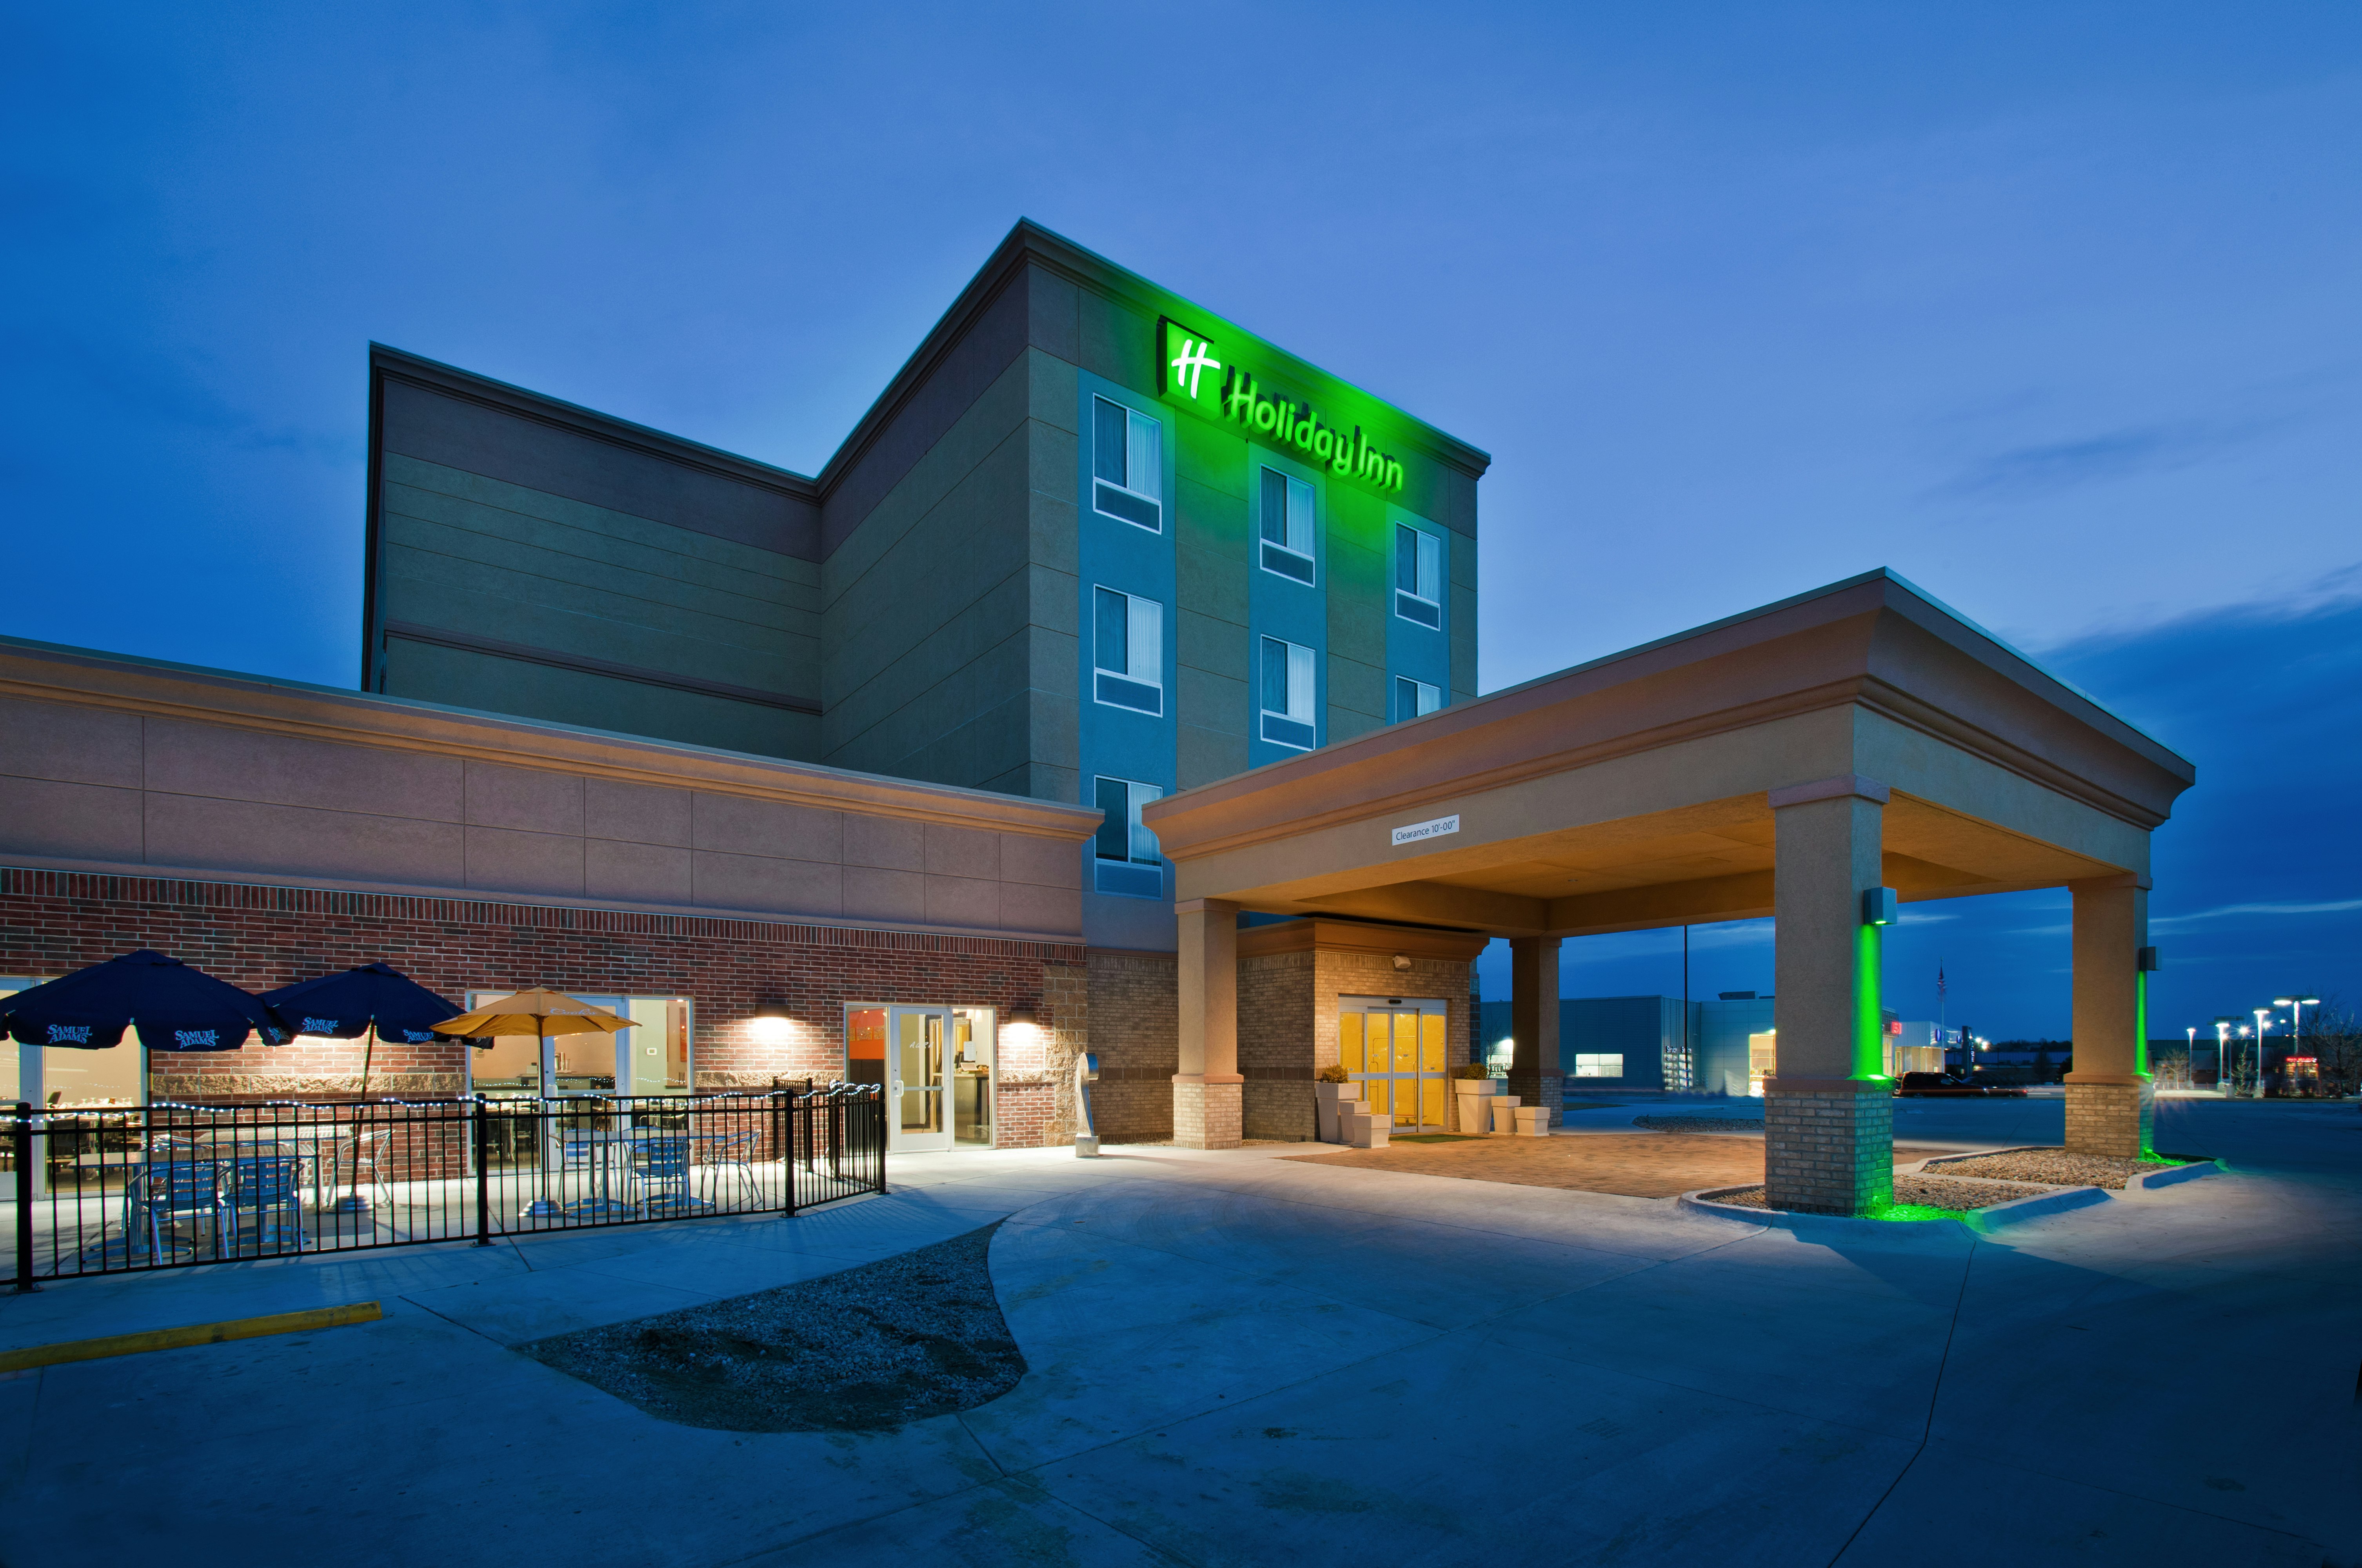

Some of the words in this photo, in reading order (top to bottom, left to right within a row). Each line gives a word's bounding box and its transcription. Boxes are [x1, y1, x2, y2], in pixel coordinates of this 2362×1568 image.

[1228, 374, 1354, 475] Holiday
[1358, 433, 1403, 490] Inn
[1396, 828, 1429, 840] Clearance
[1432, 820, 1455, 833] 10'-00"
[302, 1017, 338, 1027] SAMUEL
[47, 1024, 93, 1036] SAMUEL
[175, 1029, 219, 1040] SAMUEL
[302, 1025, 332, 1034] ADAMS
[48, 1034, 88, 1044] ADAMS
[180, 1038, 216, 1049] ADAMS
